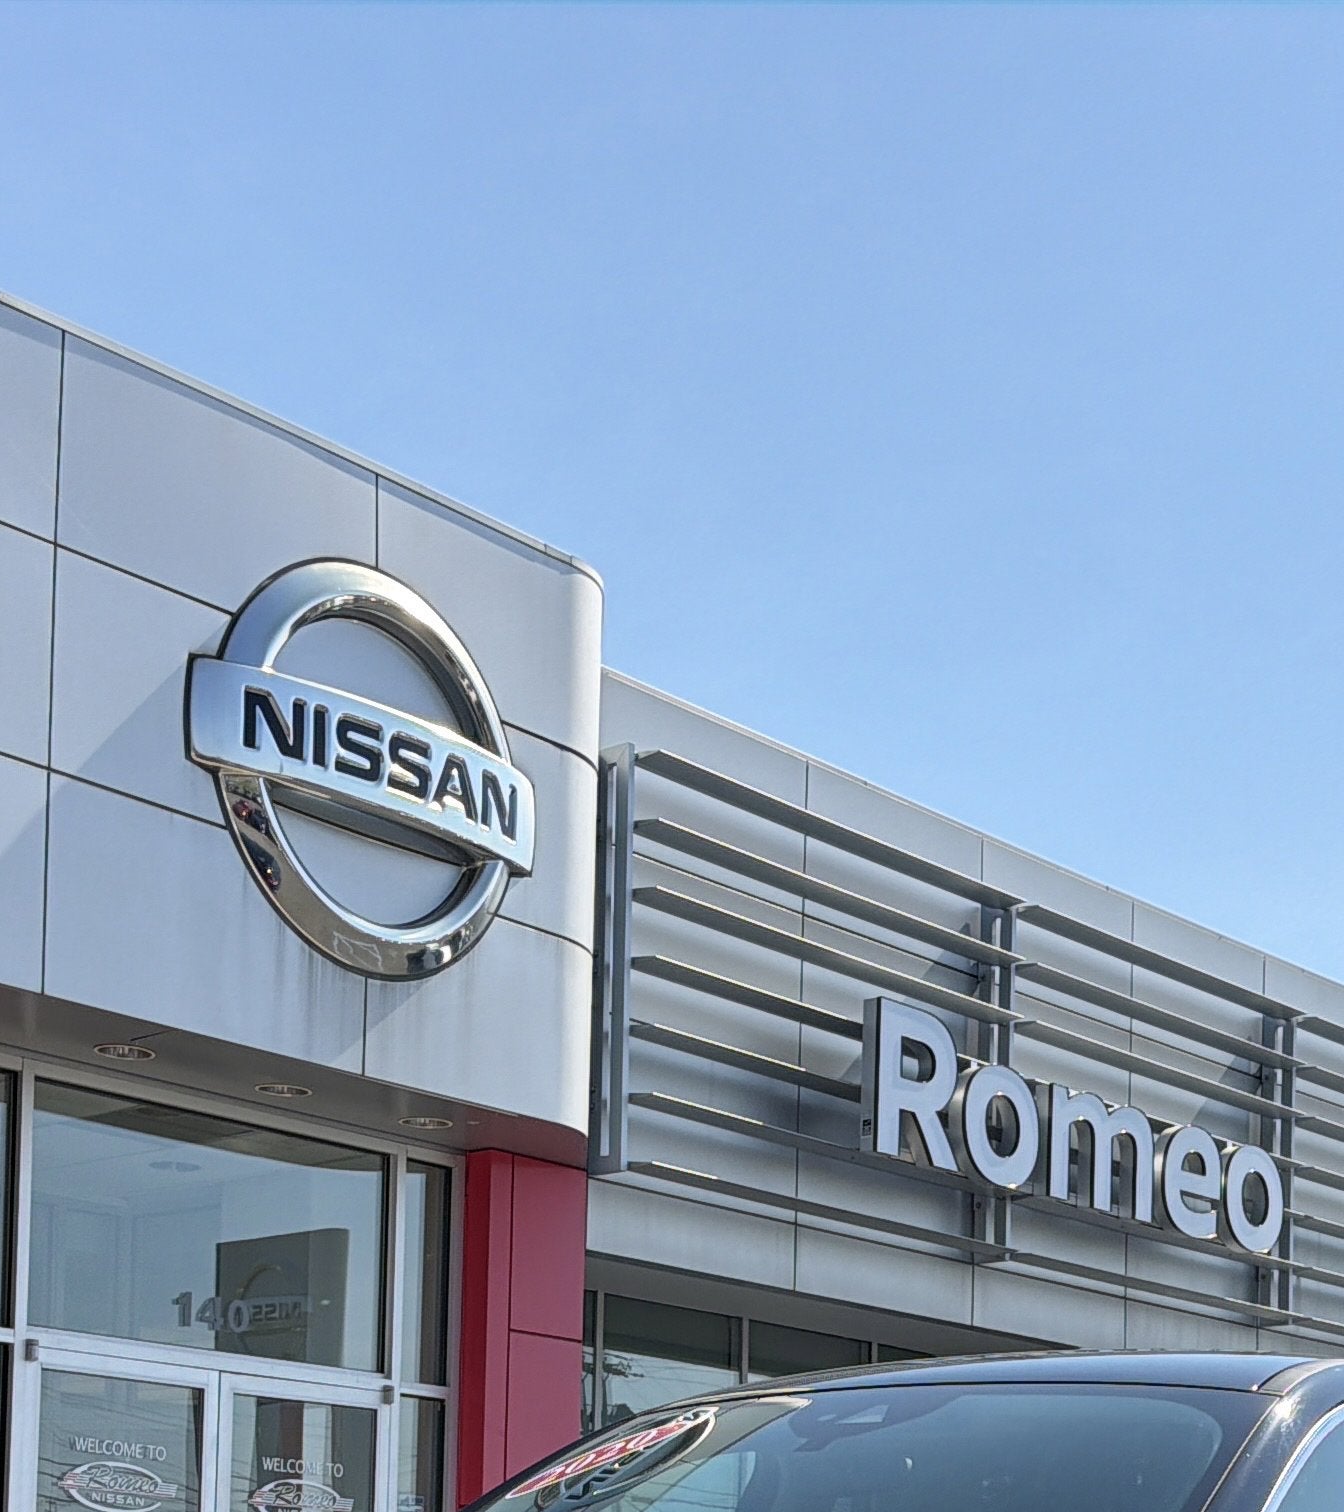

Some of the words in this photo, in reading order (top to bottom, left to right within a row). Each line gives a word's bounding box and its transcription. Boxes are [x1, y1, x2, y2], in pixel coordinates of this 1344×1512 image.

[242, 685, 517, 845] NISSAN
[863, 997, 1284, 1254] Romeo
[172, 1291, 250, 1333] 140
[74, 1436, 143, 1458] WELCOME
[147, 1445, 167, 1461] TO
[86, 1464, 160, 1493] Romeo
[262, 1456, 324, 1475] WELCOME
[327, 1463, 344, 1477] TO
[92, 1492, 145, 1506] NISSAN
[273, 1482, 337, 1510] Romeo
